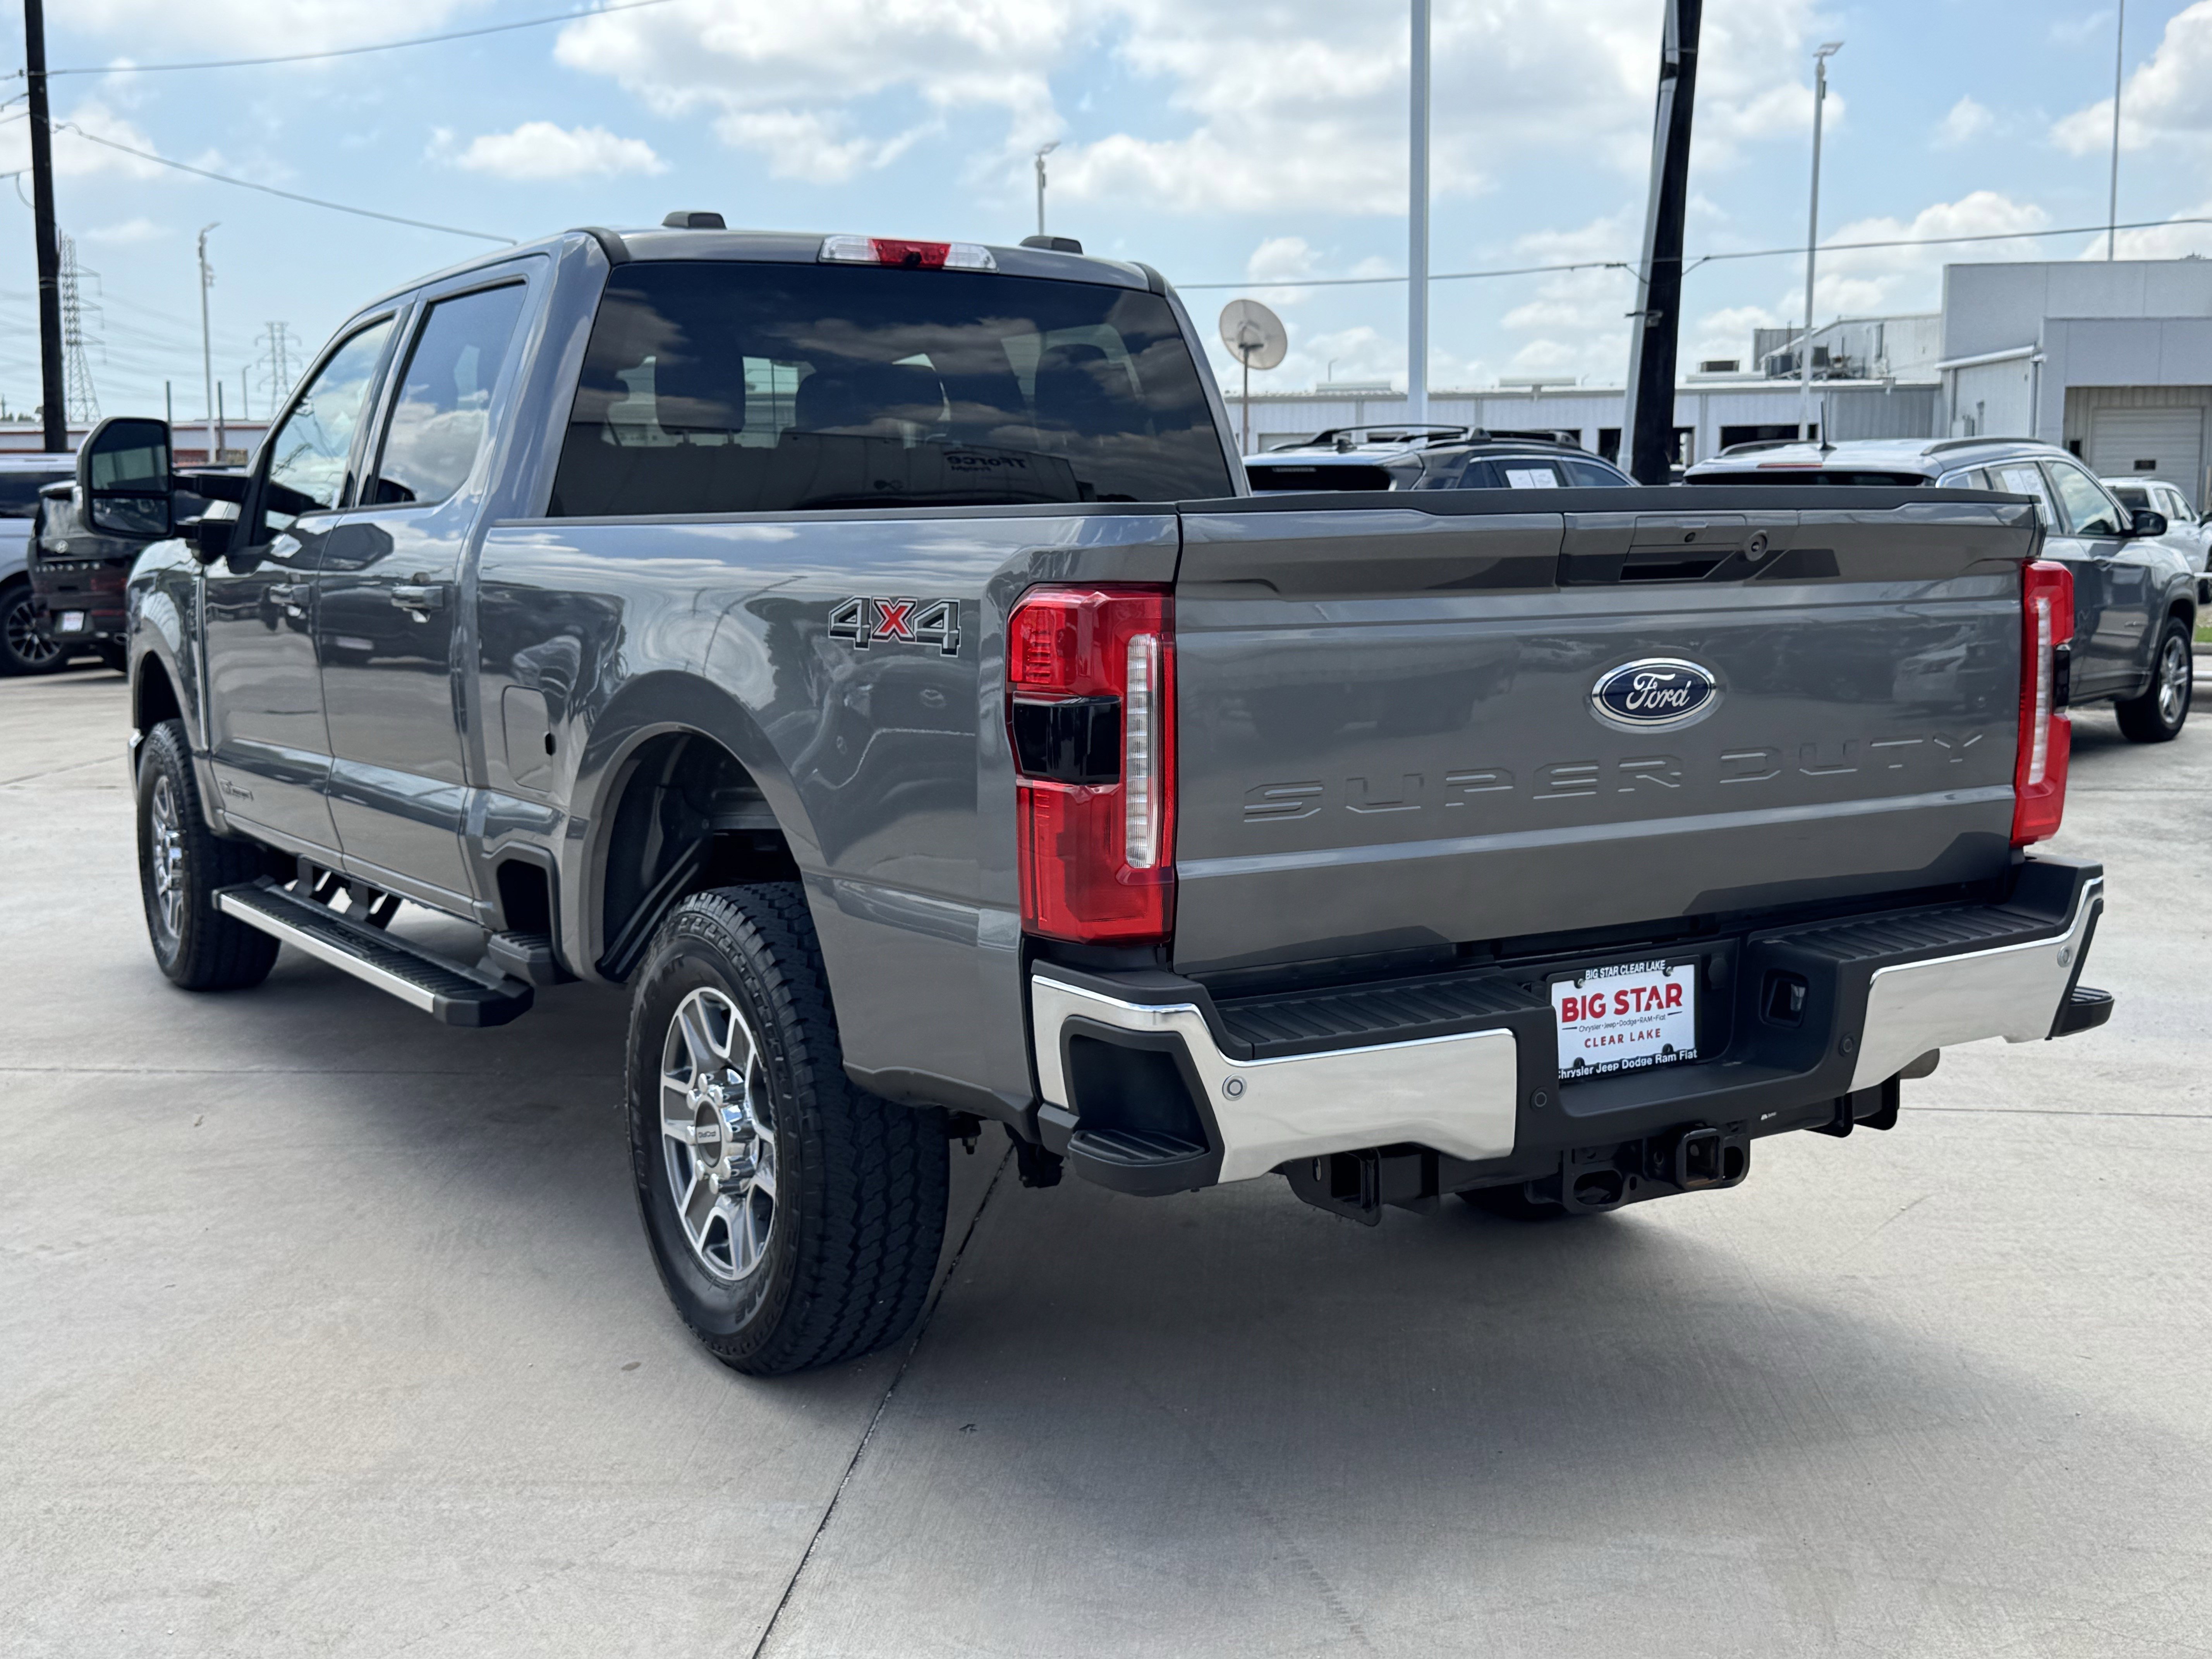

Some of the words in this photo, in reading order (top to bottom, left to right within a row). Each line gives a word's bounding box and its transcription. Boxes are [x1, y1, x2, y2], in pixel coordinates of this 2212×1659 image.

[1625, 673, 1692, 711] Ford
[1244, 754, 1681, 823] SUPER
[1719, 733, 1983, 784] DUTY
[1585, 969, 1599, 980] BIG
[1600, 965, 1619, 978] STAR
[1620, 962, 1645, 975] CLEAR
[1646, 960, 1666, 971] LAKE
[1562, 993, 1606, 1023] BIG
[1614, 982, 1683, 1015] STAR
[1584, 1033, 1624, 1048] CLEAR
[1630, 1028, 1661, 1042] LAKE
[1596, 1062, 1619, 1074] Jeep
[1622, 1057, 1652, 1069] Dodge
[1655, 1053, 1677, 1064] Ram
[1679, 1049, 1698, 1060] Fiat
